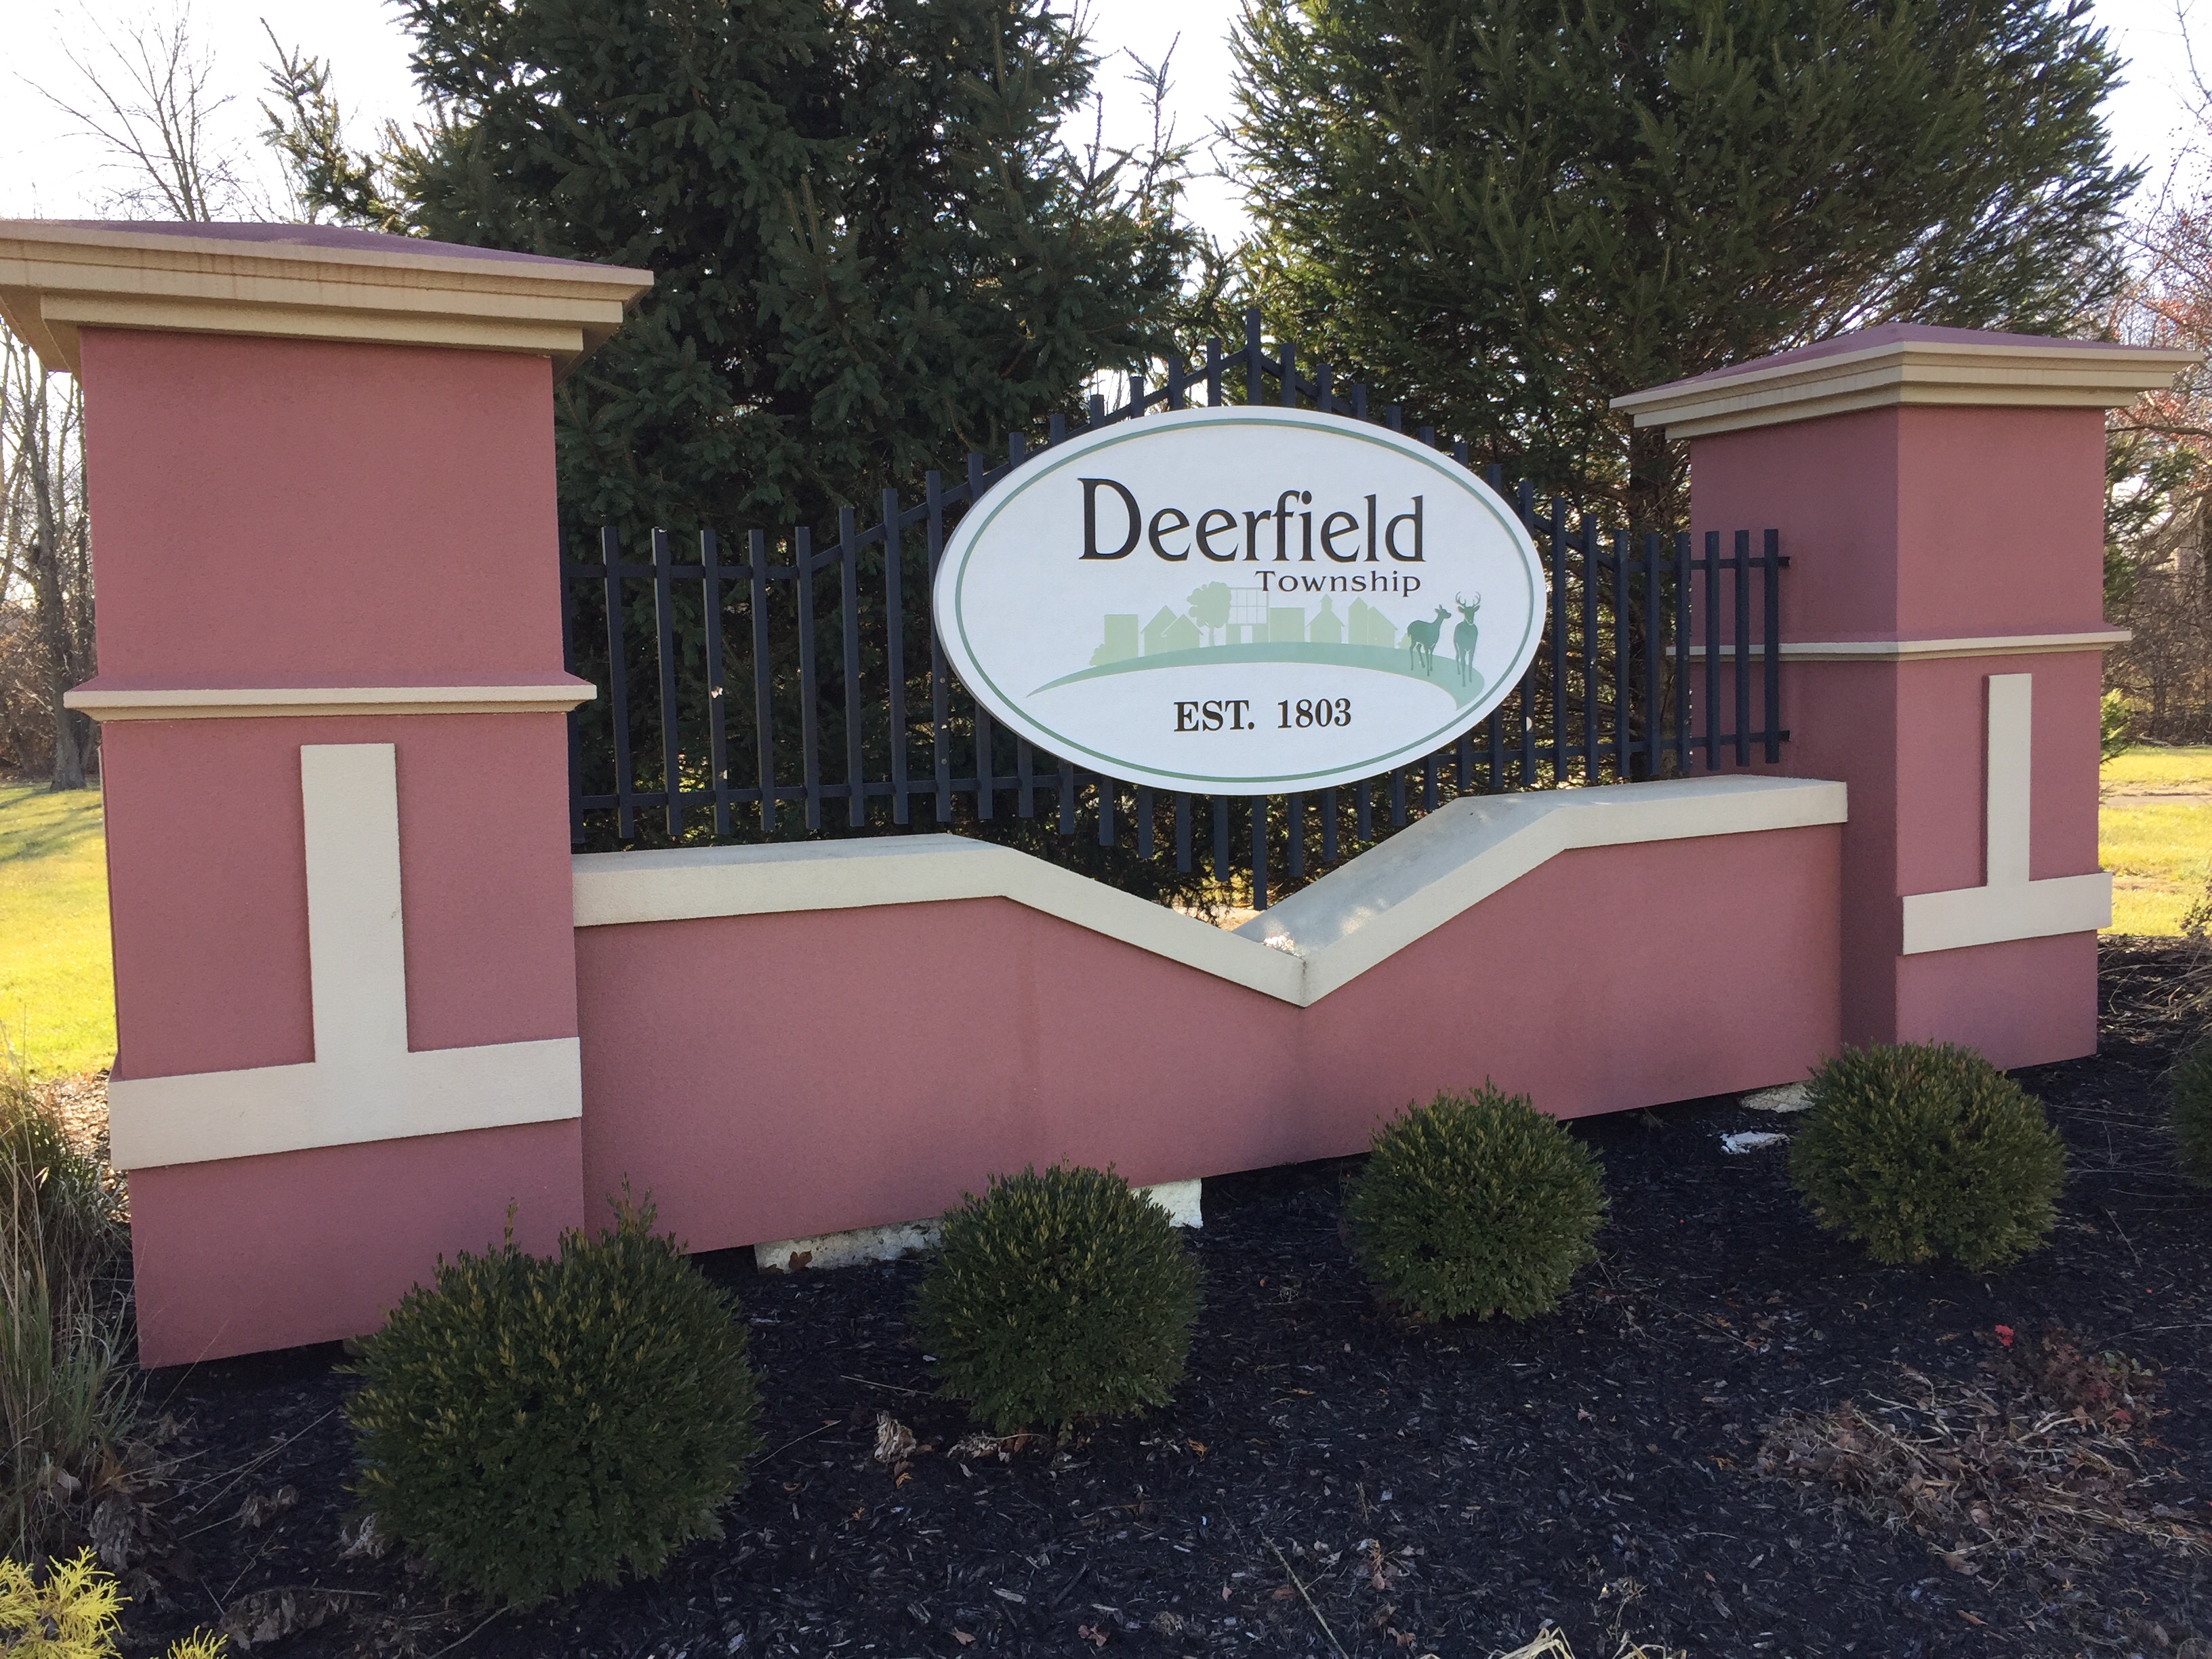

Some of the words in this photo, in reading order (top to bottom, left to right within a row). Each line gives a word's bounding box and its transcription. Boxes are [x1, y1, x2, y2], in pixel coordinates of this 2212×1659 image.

[1077, 477, 1426, 563] Deerfield
[1254, 570, 1421, 598] Township
[1173, 699, 1254, 732] EST.
[1277, 698, 1351, 729] 1803
